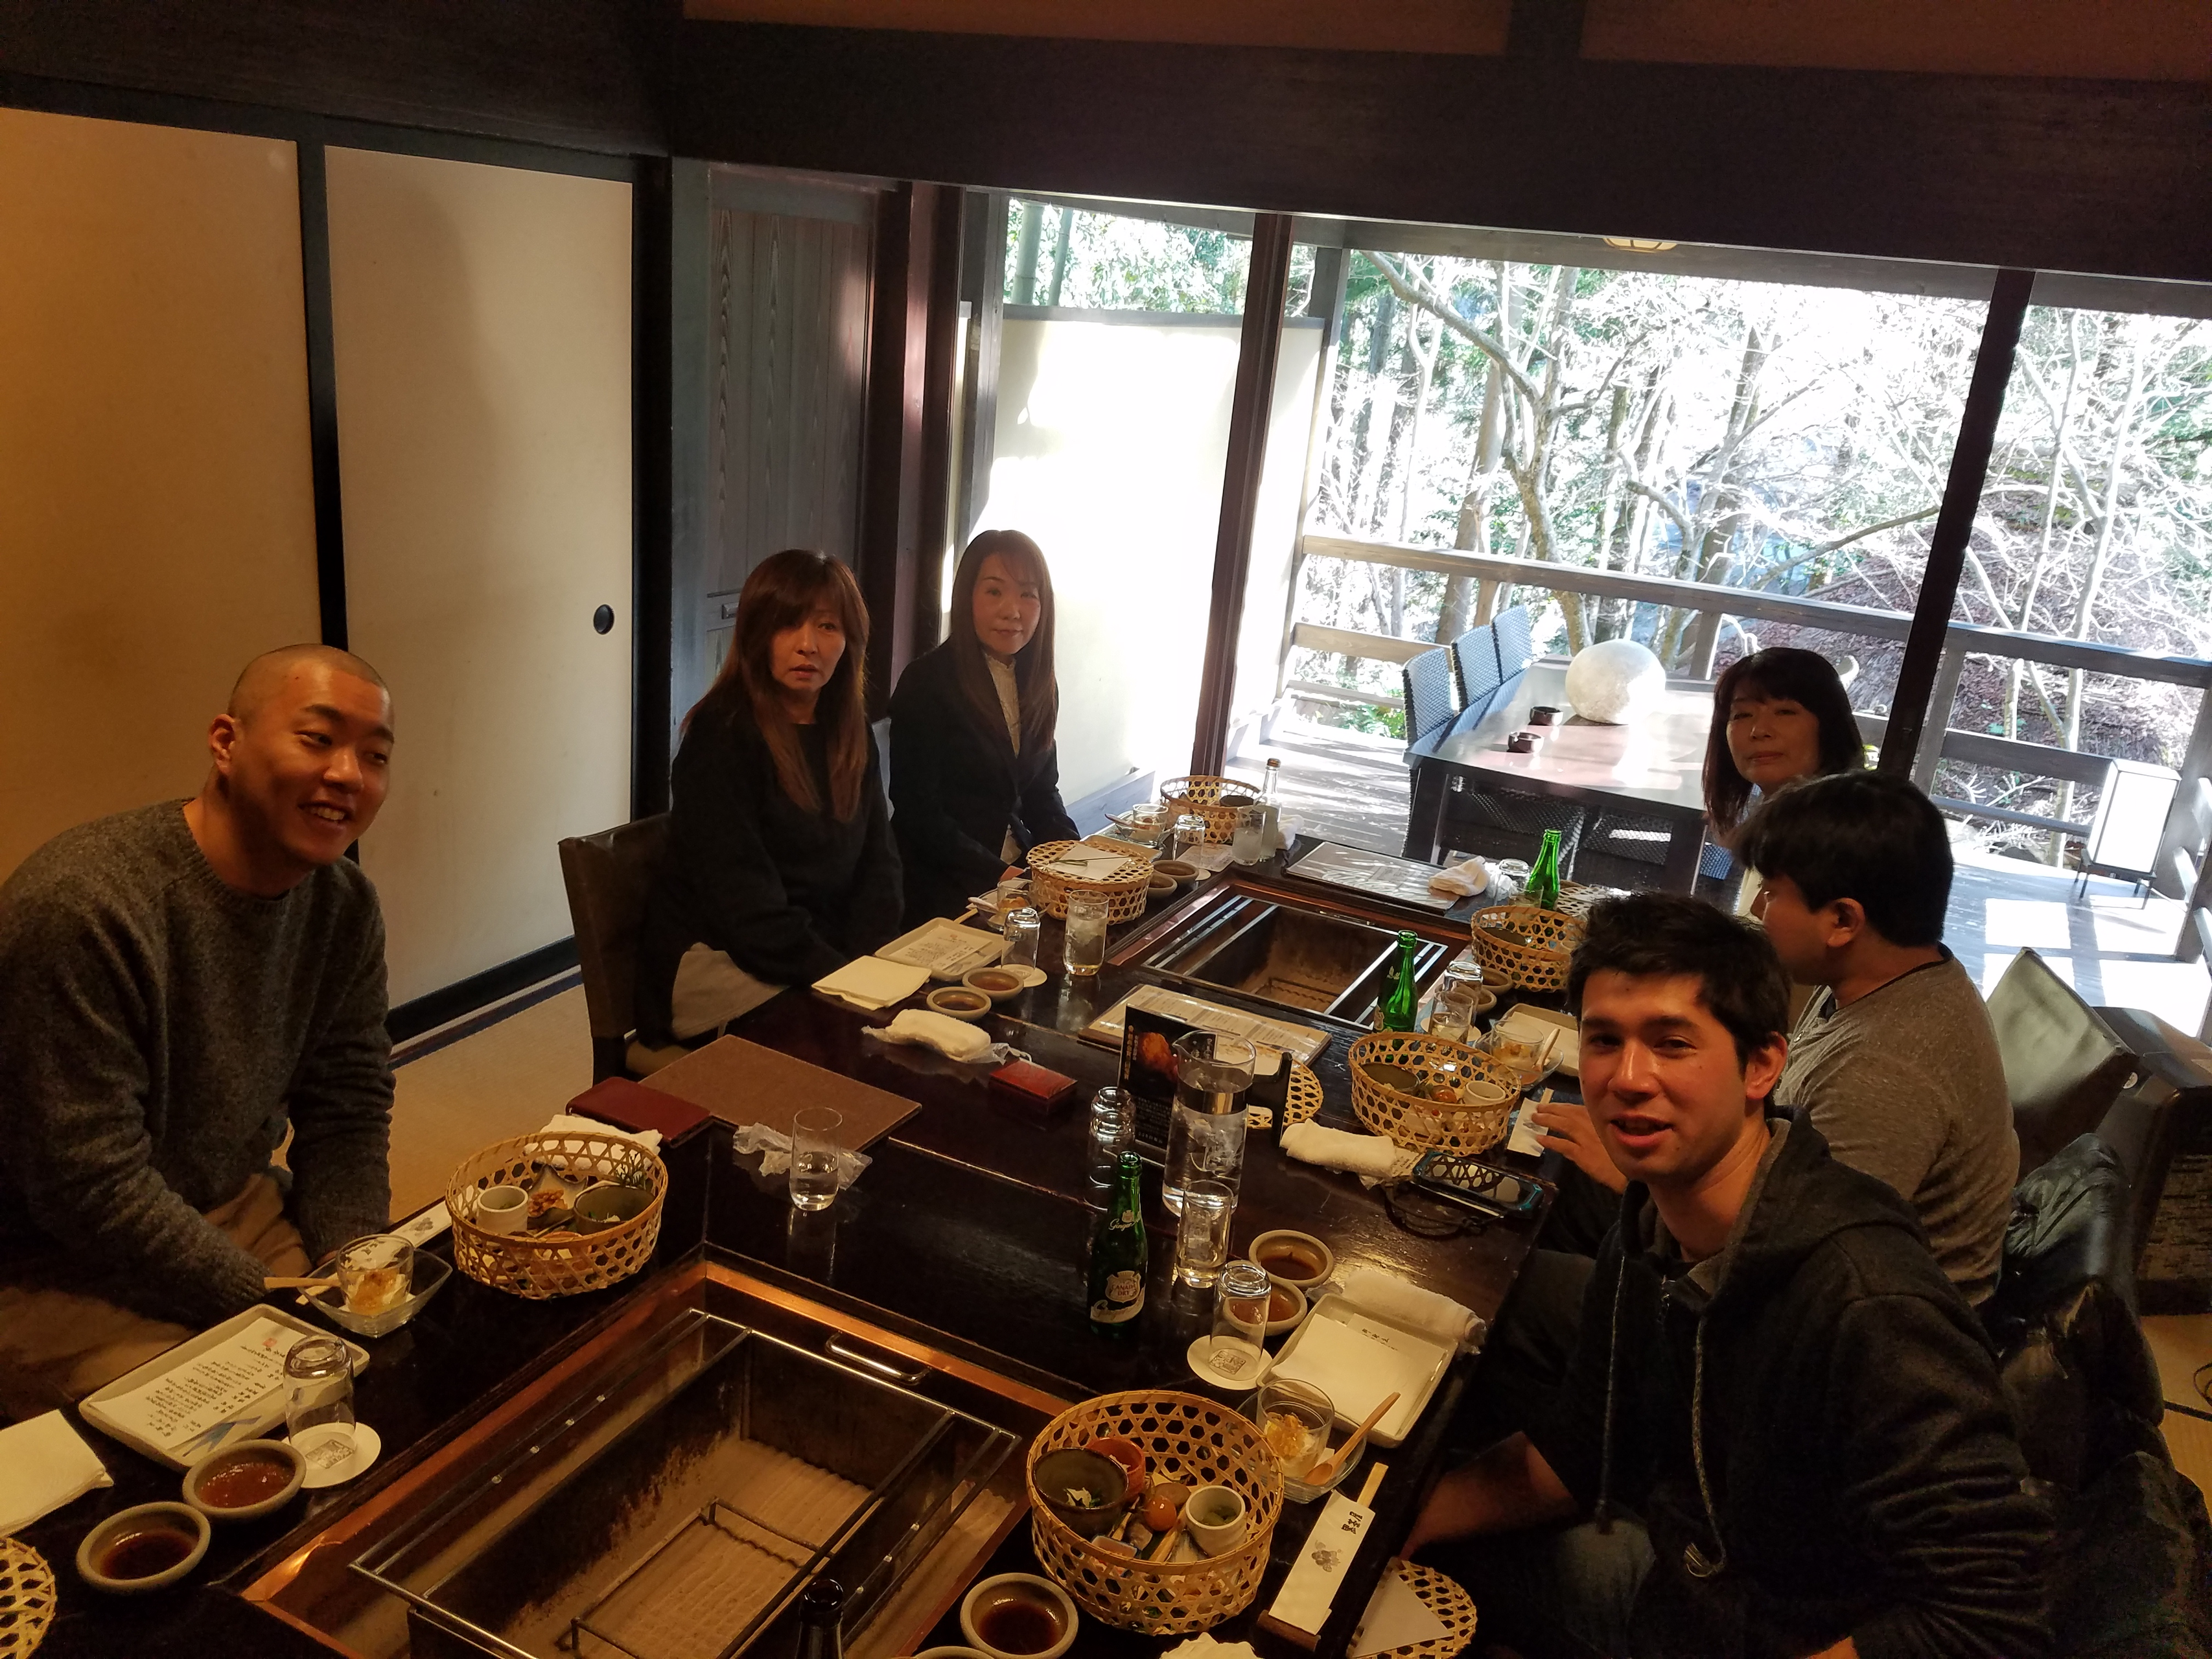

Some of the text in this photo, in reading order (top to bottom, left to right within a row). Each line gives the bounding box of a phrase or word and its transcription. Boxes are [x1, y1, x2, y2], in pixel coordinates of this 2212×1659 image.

[1108, 1218, 1134, 1231] Ginger
[1341, 1511, 1363, 1535] 黒茶屋
